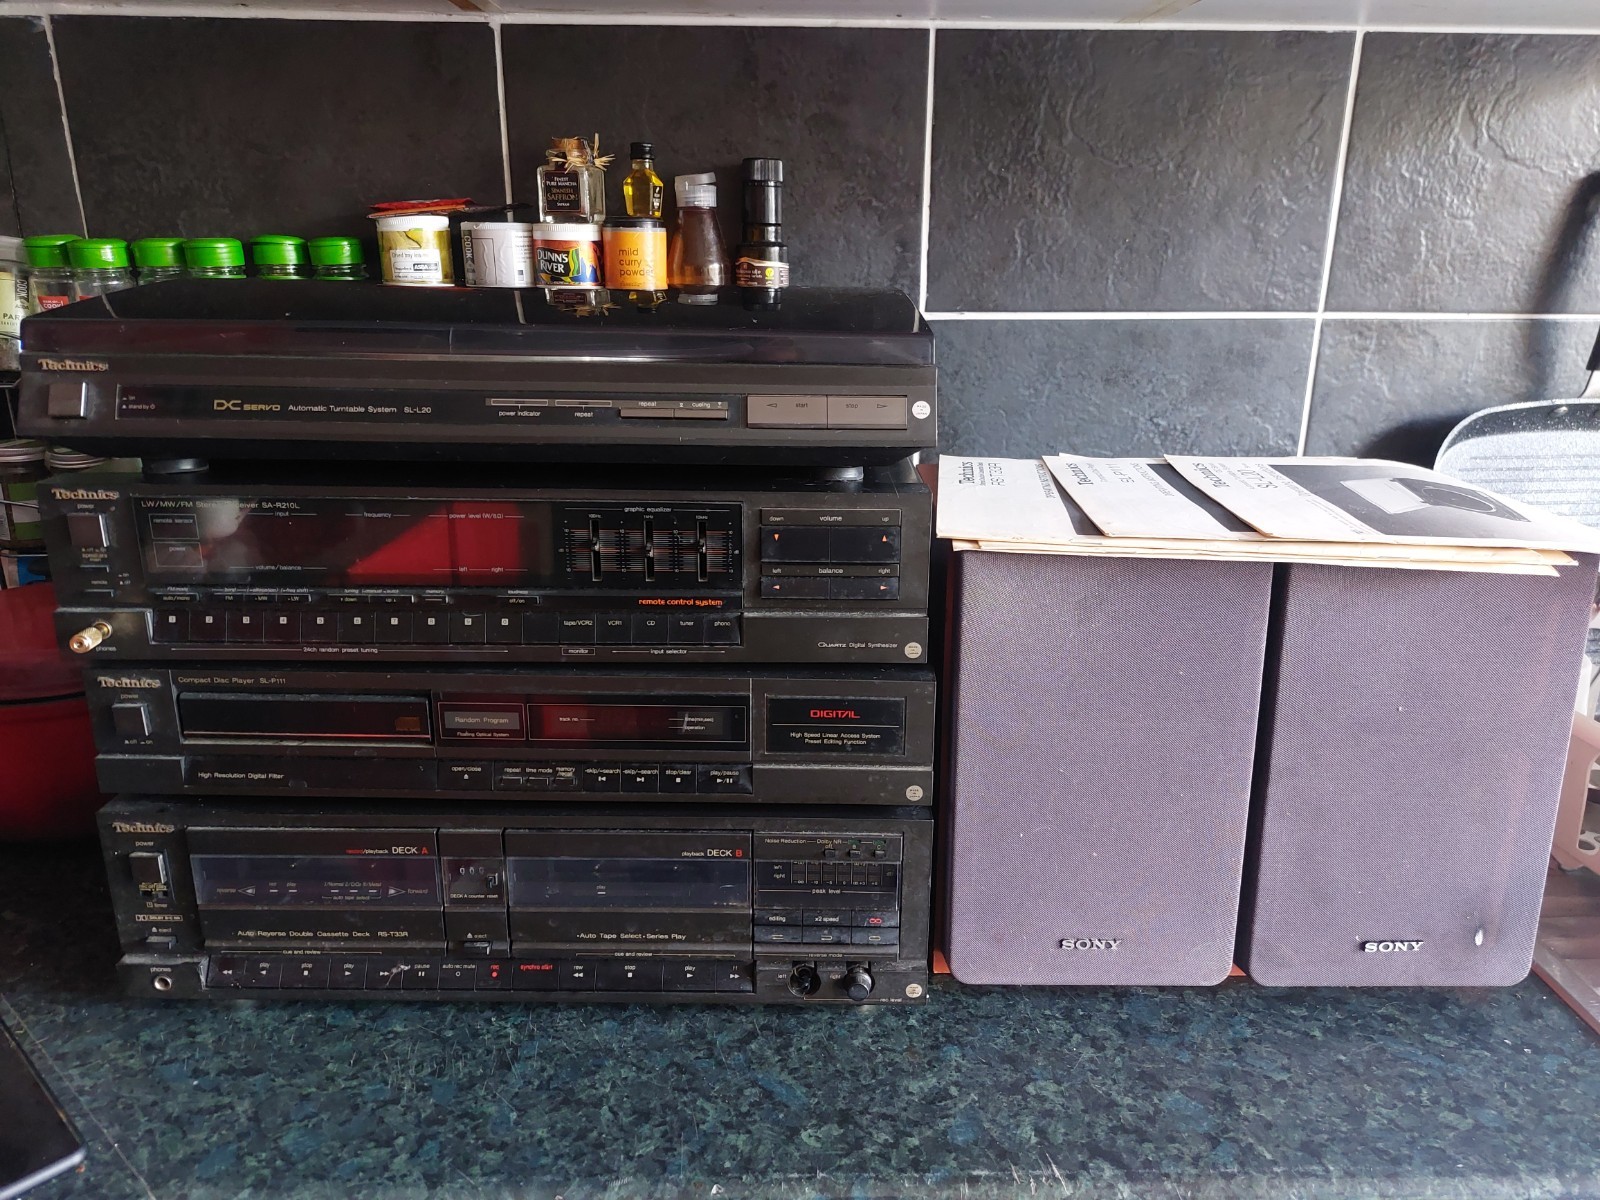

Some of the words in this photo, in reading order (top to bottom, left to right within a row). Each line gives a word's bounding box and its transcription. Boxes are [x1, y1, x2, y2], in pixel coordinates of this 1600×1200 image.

[464, 236, 473, 258] COOK
[619, 248, 638, 256] mild
[537, 249, 568, 263] DUNN'S
[540, 262, 565, 273] RIVER
[619, 258, 642, 267] curry
[38, 359, 109, 371] Technics
[214, 399, 241, 410] DC
[368, 406, 397, 414] System
[404, 406, 432, 414] SL-L20
[959, 461, 975, 485] Technics
[1067, 462, 1094, 486] Technics
[1193, 462, 1231, 488] Technics
[52, 488, 120, 500] Technics
[98, 676, 161, 688] Technics
[810, 709, 861, 718] DIGITAL
[112, 822, 174, 833] Technics
[1060, 939, 1121, 950] SONY
[1363, 940, 1424, 953] SONY
